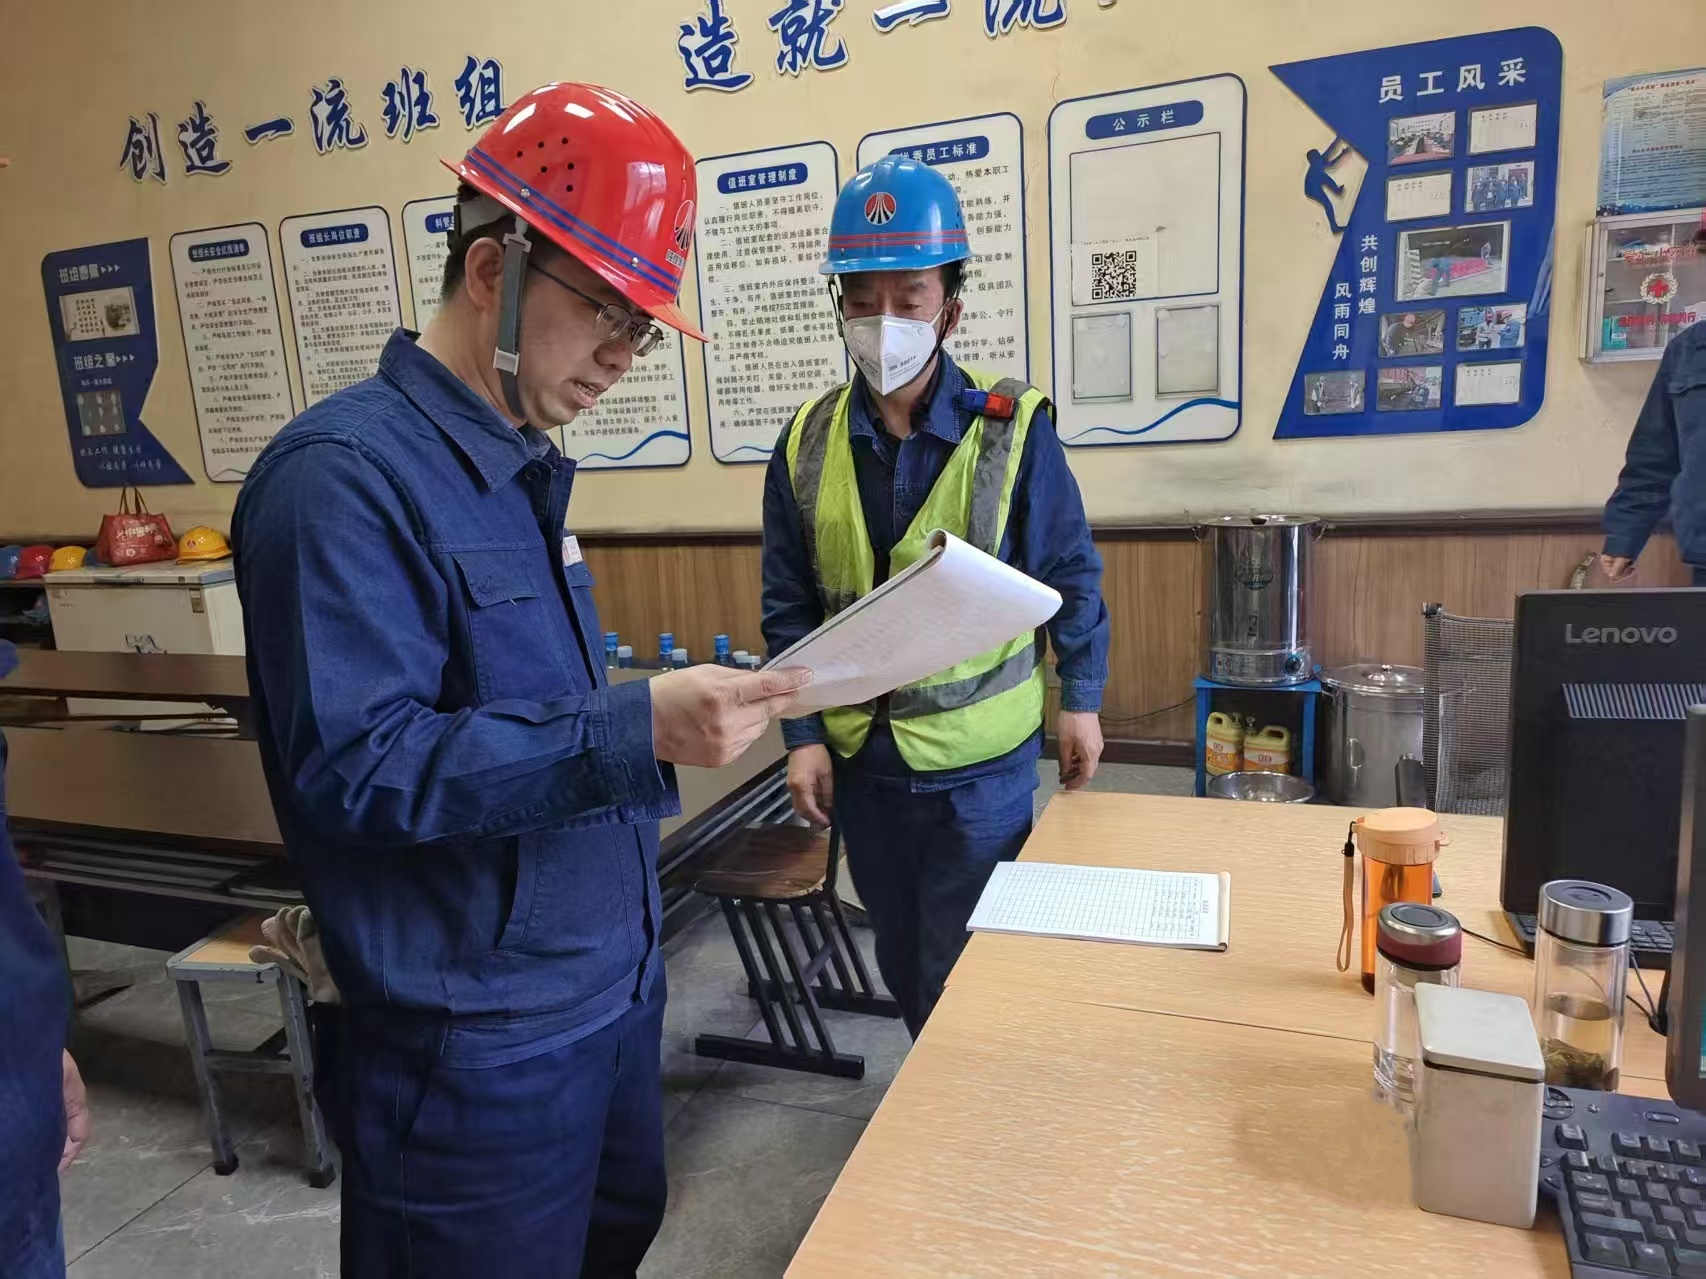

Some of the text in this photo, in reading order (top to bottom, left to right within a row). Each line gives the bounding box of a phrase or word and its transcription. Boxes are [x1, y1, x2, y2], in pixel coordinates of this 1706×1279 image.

[1379, 58, 1526, 103] 员工风采
[120, 56, 508, 183] 创造一流班组
[1113, 110, 1176, 131] 公示栏
[728, 168, 797, 189] 值班室管理制度
[1358, 234, 1378, 315] 共创辉煌
[1333, 282, 1352, 360] 风雨同舟
[1565, 624, 1678, 644] Lenovo
